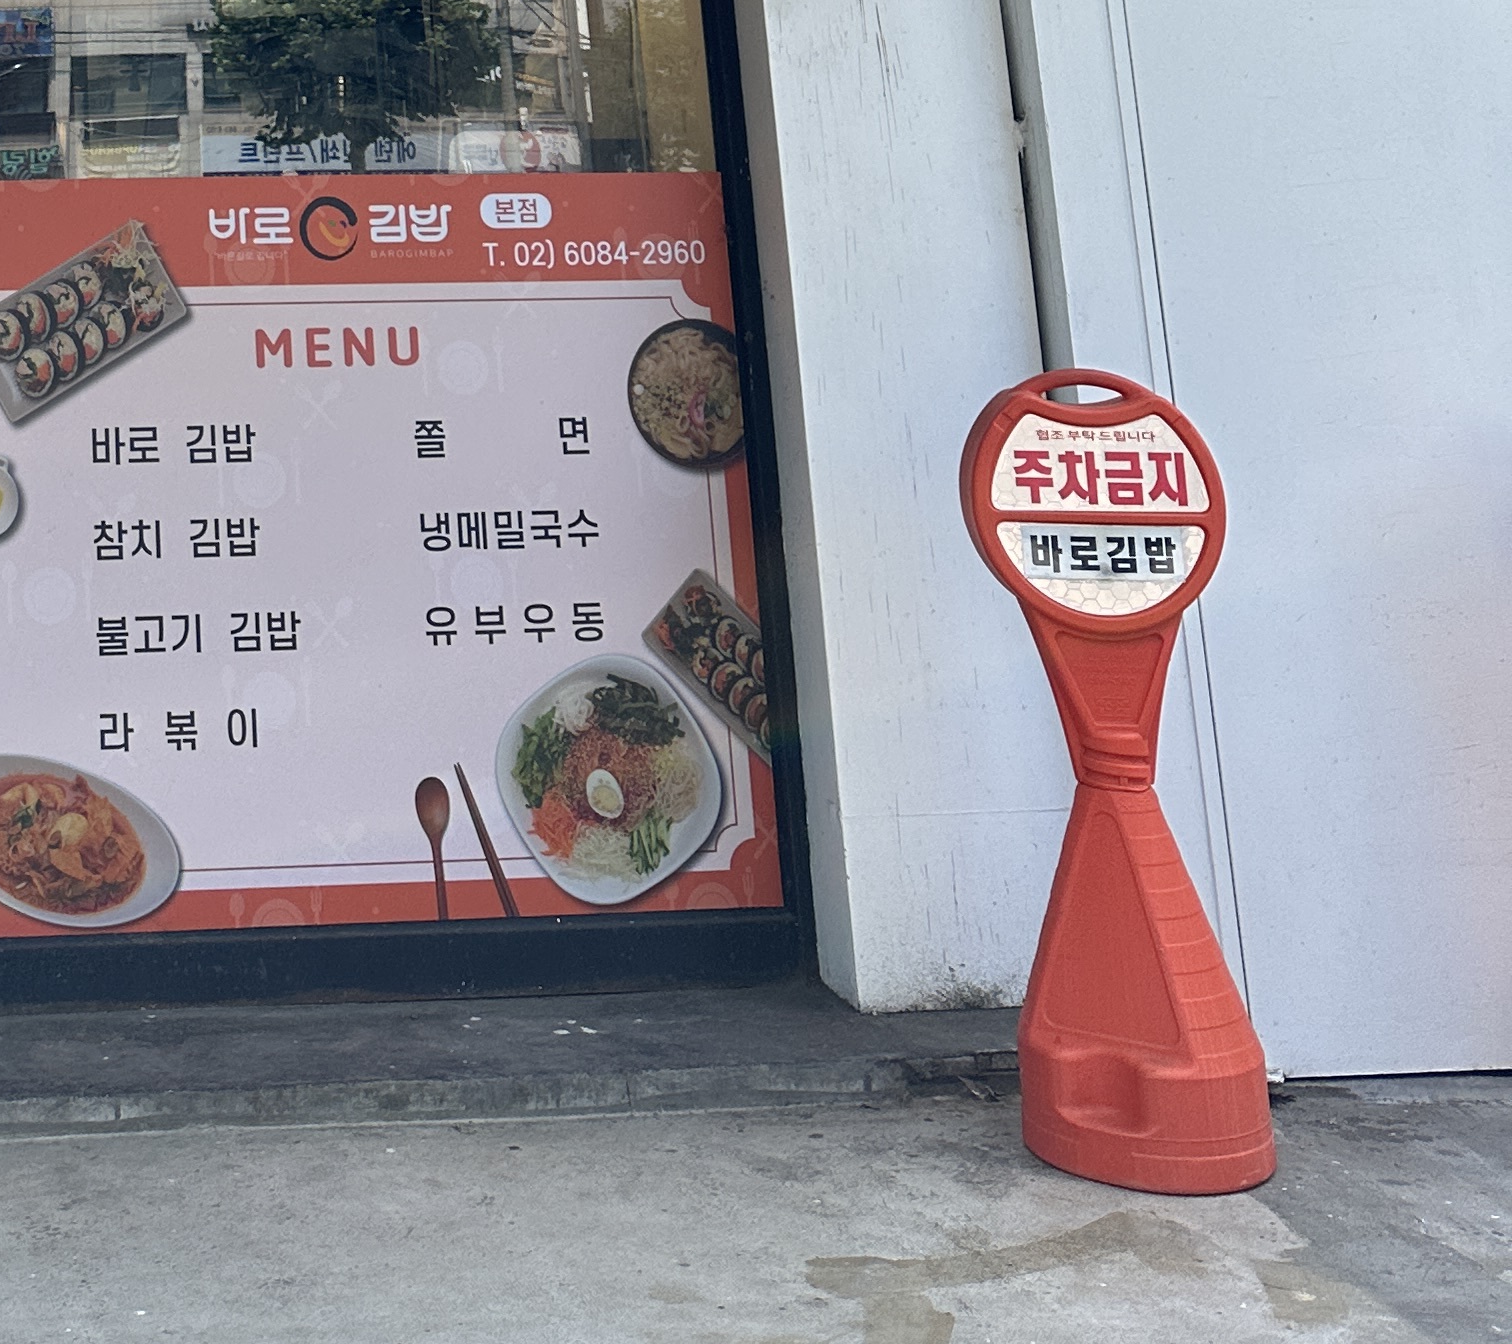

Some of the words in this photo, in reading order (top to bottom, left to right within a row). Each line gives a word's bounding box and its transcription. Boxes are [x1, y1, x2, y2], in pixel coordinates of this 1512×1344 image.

[209, 207, 294, 244] 바로
[368, 204, 452, 243] 김밥
[494, 197, 537, 225] 본점
[370, 249, 454, 259] BAROGIMBAP
[483, 242, 507, 267] T.
[514, 241, 555, 268] 02)
[563, 239, 706, 267] 6084-2960
[255, 326, 421, 369] MENU
[91, 426, 160, 465] 바로
[185, 423, 256, 464] 김밥
[1068, 430, 1095, 441] 부탁
[1013, 449, 1188, 506] 주차금지
[93, 519, 162, 560] 참치
[189, 517, 260, 558] 김밥
[419, 509, 600, 552] 냉메밀국수
[1030, 534, 1177, 574] 바로김밥
[96, 614, 203, 657] 불고기
[229, 611, 301, 652] 김밥
